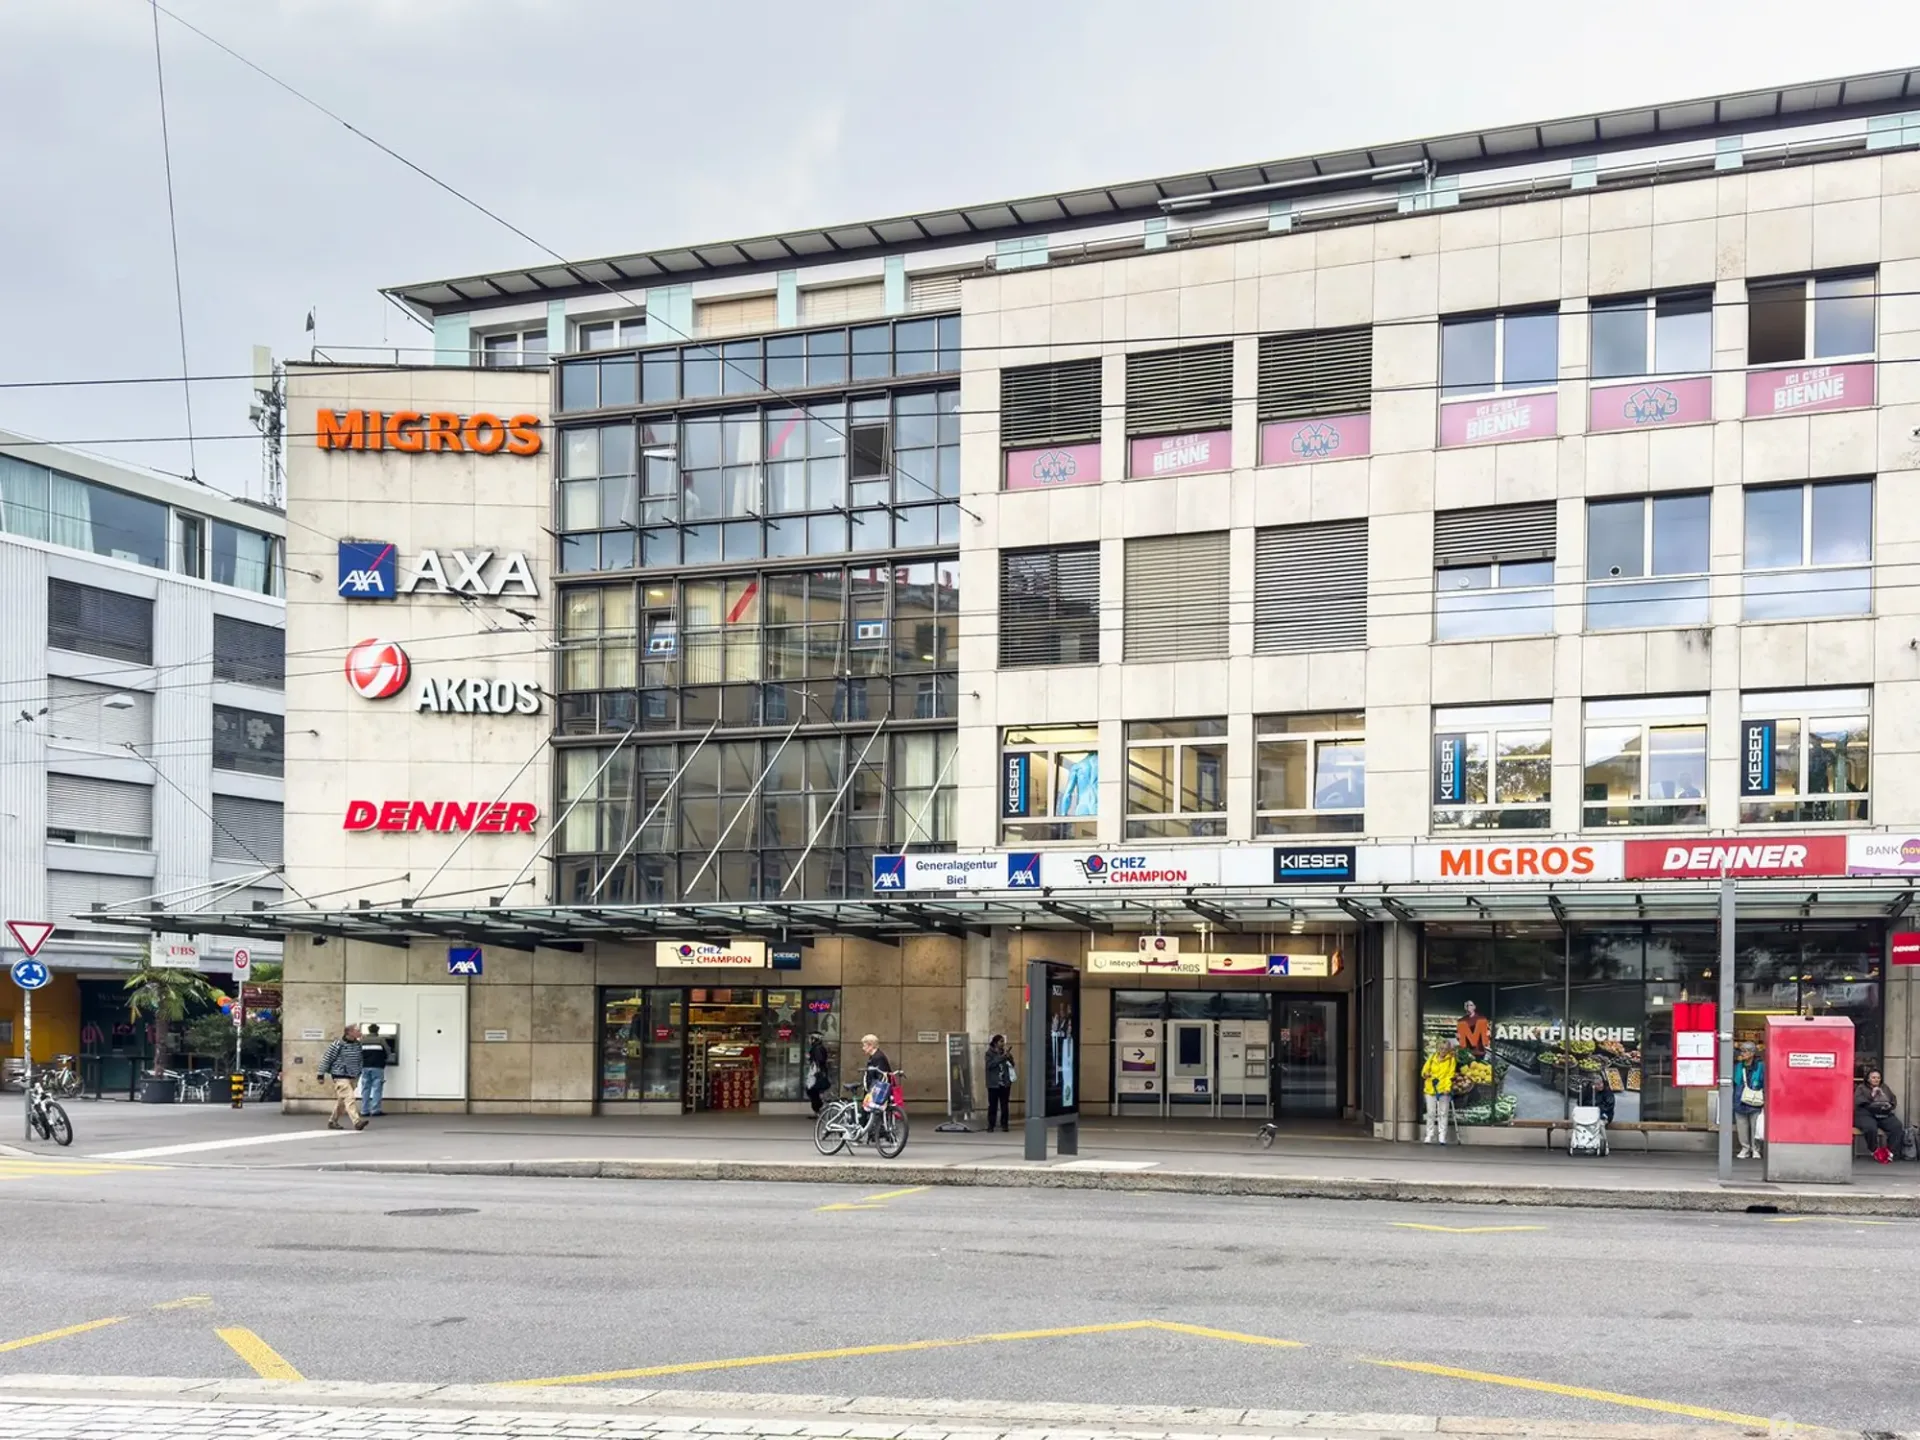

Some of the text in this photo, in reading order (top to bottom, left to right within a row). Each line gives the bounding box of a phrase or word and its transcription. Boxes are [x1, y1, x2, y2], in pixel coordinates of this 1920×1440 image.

[1774, 376, 1844, 410] BIENNE
[316, 408, 543, 456] MIGROS
[1466, 408, 1531, 440] BIENNE
[1154, 443, 1210, 472] BIENNE
[338, 569, 385, 592] AXA
[401, 550, 540, 597] AXA
[415, 677, 541, 714] AKROS
[1441, 739, 1454, 800] KIESER
[1748, 726, 1762, 791] KIESER
[1008, 757, 1020, 813] KIESER
[343, 800, 540, 833] DENNER
[1280, 854, 1348, 868] KIESER
[1440, 847, 1595, 876] MIGROS
[1663, 844, 1808, 871] DENNER
[1866, 846, 1899, 856] BANK
[915, 859, 998, 872] Generalagentur
[1110, 857, 1146, 869] CHEZ
[874, 872, 901, 887] AXA
[947, 875, 967, 885] Biel
[1008, 870, 1035, 885] AXA
[1110, 870, 1187, 883] CHAMPION
[171, 946, 196, 956] UBS
[696, 946, 723, 954] CHEZ
[696, 956, 752, 964] CHAMPION
[450, 961, 478, 973] AXA
